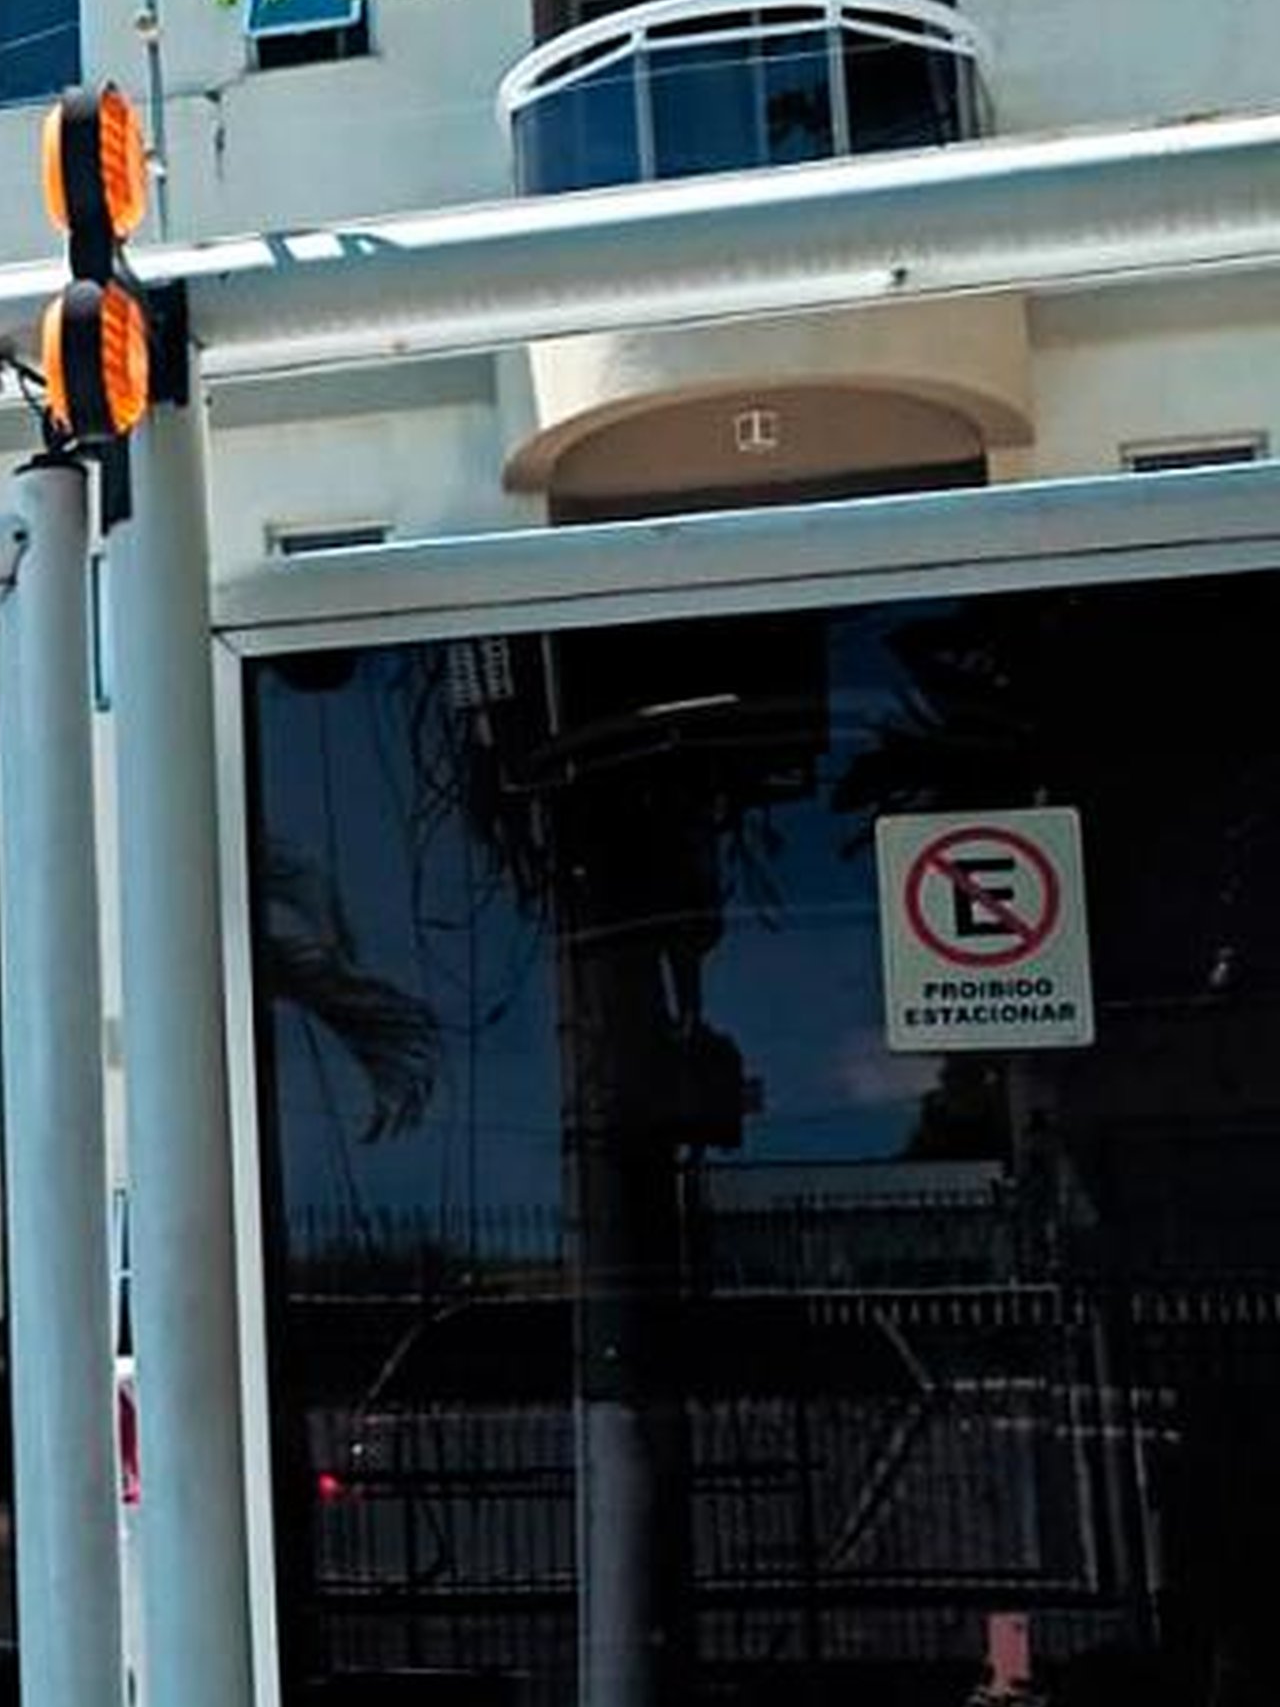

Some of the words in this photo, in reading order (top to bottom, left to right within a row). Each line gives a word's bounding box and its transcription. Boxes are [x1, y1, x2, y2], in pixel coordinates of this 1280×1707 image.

[953, 858, 1016, 937] E
[922, 978, 1053, 1000] PROIBIDO
[904, 1002, 1077, 1027] ESTACIONAR
